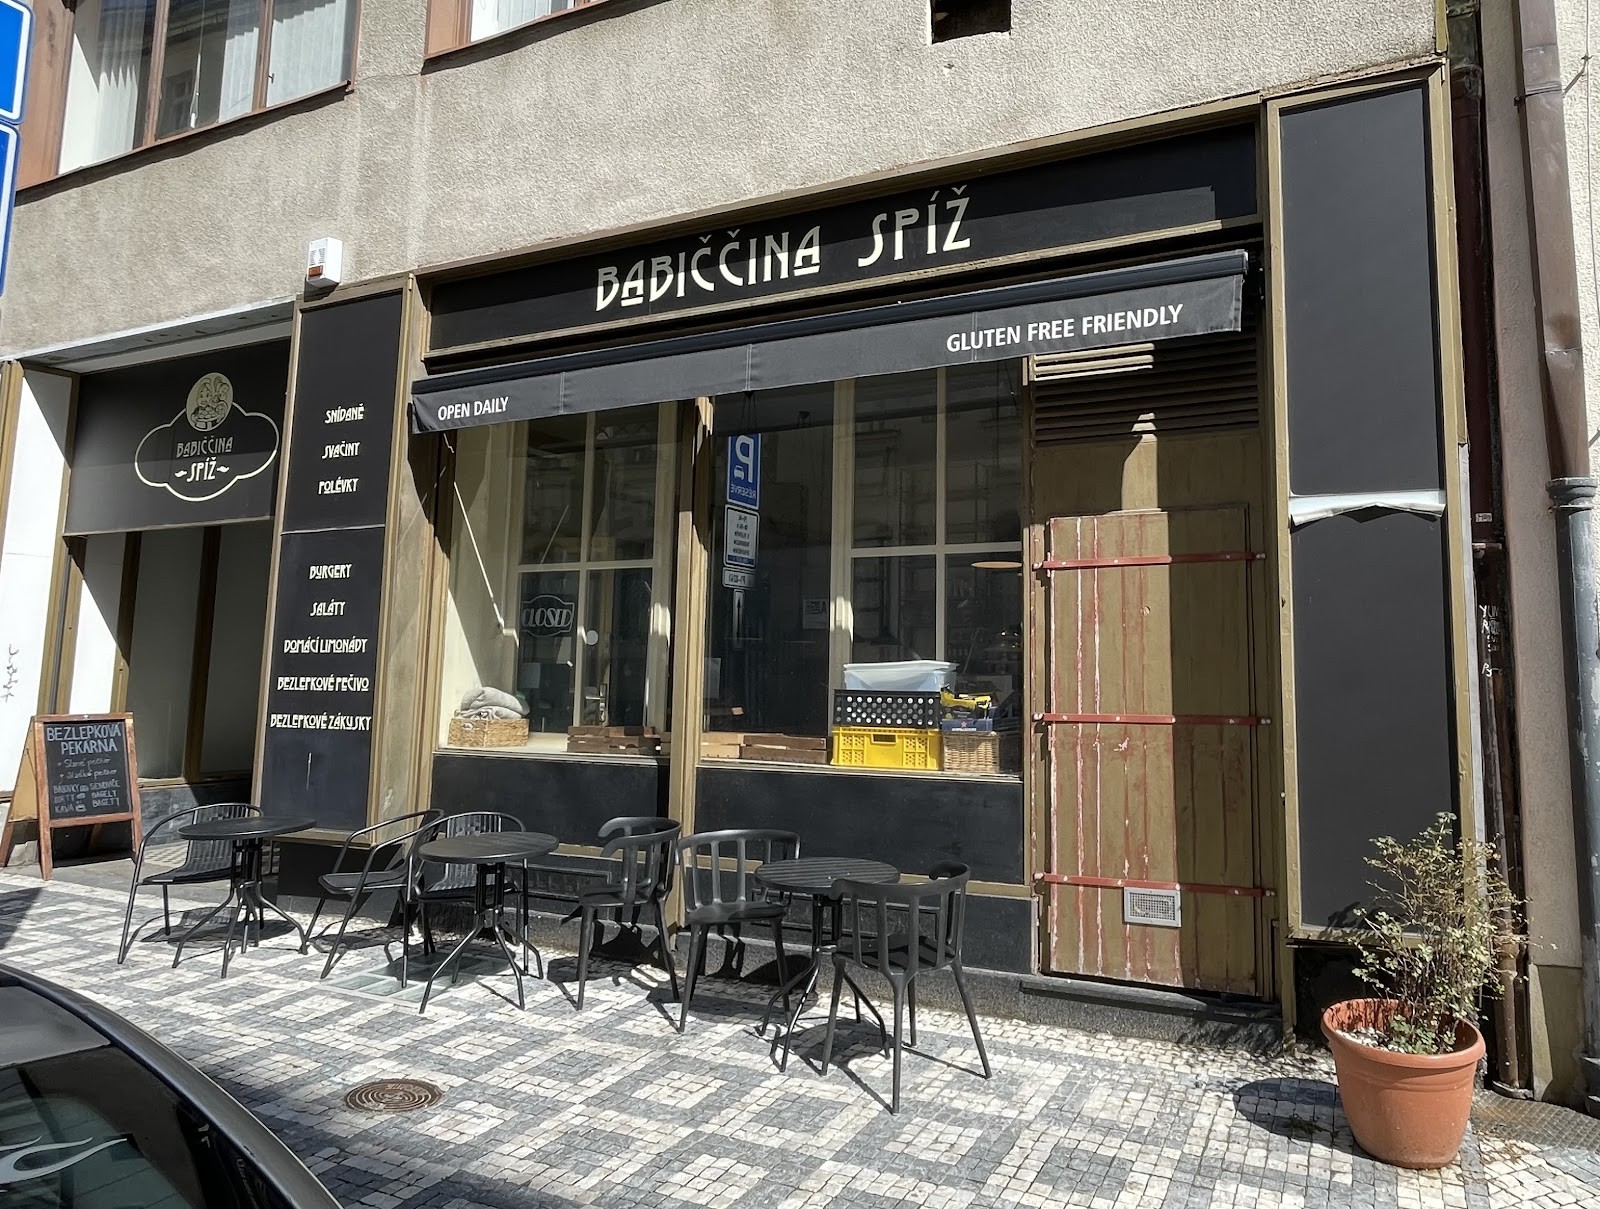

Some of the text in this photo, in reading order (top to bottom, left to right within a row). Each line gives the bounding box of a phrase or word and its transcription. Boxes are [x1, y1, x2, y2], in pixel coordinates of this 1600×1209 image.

[596, 184, 971, 311] BABIČČINA SPÍŽ
[946, 304, 1184, 352] GLUTEN FREE FRIENDLY
[324, 403, 365, 424] SNÍDANĚ
[438, 396, 509, 421] OPEN DAILY
[176, 435, 233, 458] BABIČČINA
[322, 441, 361, 459] SVAČINY
[186, 456, 217, 482] SPÍŽ
[318, 476, 359, 495] POLÉVKY
[309, 564, 352, 579] BURGERY
[310, 599, 346, 616] SALÁTY
[283, 635, 368, 653] DOMÁCÍ LIMONÁDY
[277, 674, 370, 691] BEZLEPKOVÉ PEČIVO
[270, 712, 372, 731] BEZLEPKOVÉ ZÁKUSKY
